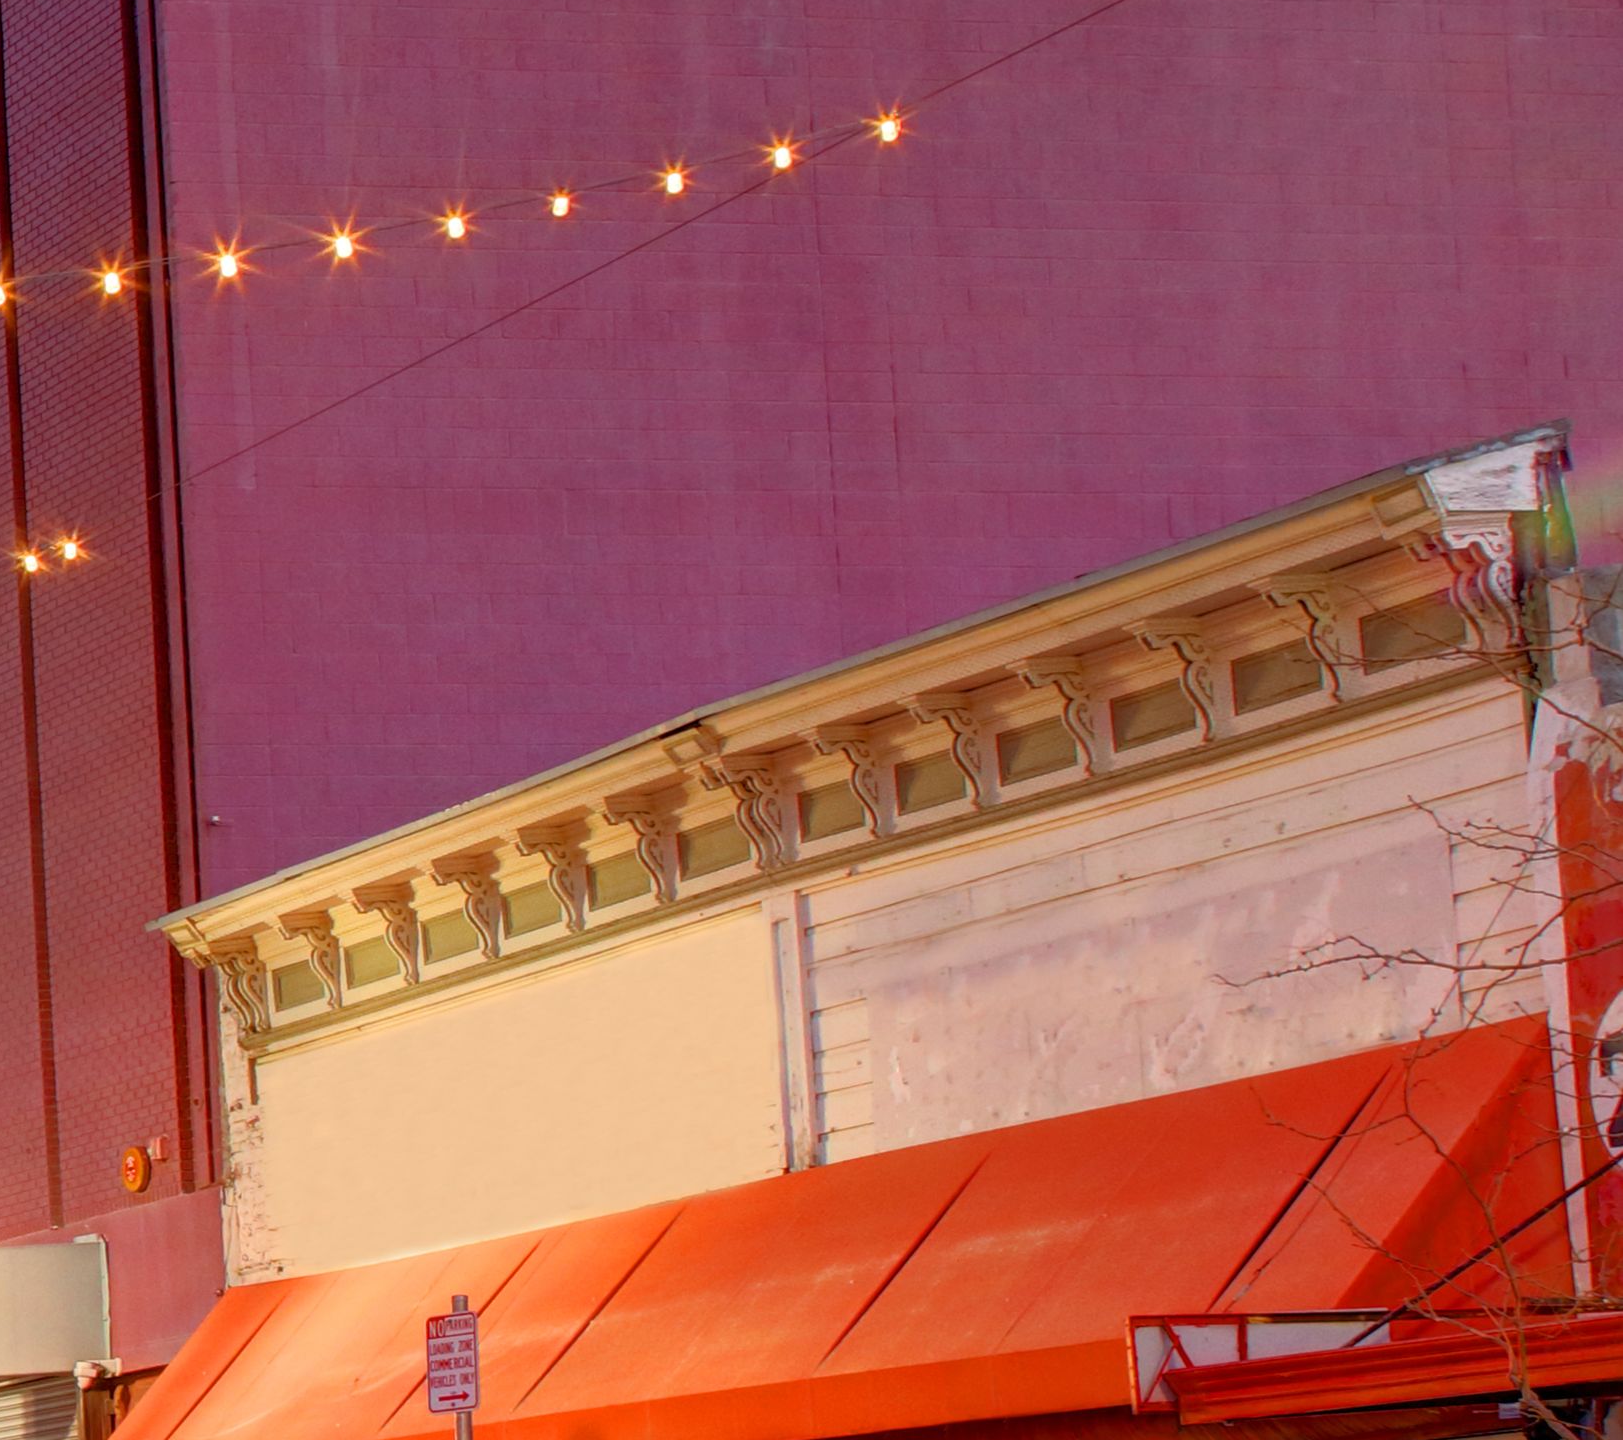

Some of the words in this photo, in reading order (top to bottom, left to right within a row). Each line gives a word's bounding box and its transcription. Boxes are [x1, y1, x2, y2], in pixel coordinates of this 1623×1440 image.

[430, 1319, 446, 1338] NO
[446, 1317, 474, 1331] PARKING
[430, 1341, 455, 1356] LOADING
[458, 1338, 474, 1352] ZONE
[430, 1356, 475, 1372] COMMERCIAL
[430, 1374, 457, 1389] VEHICLES
[460, 1372, 475, 1386] ONLY
